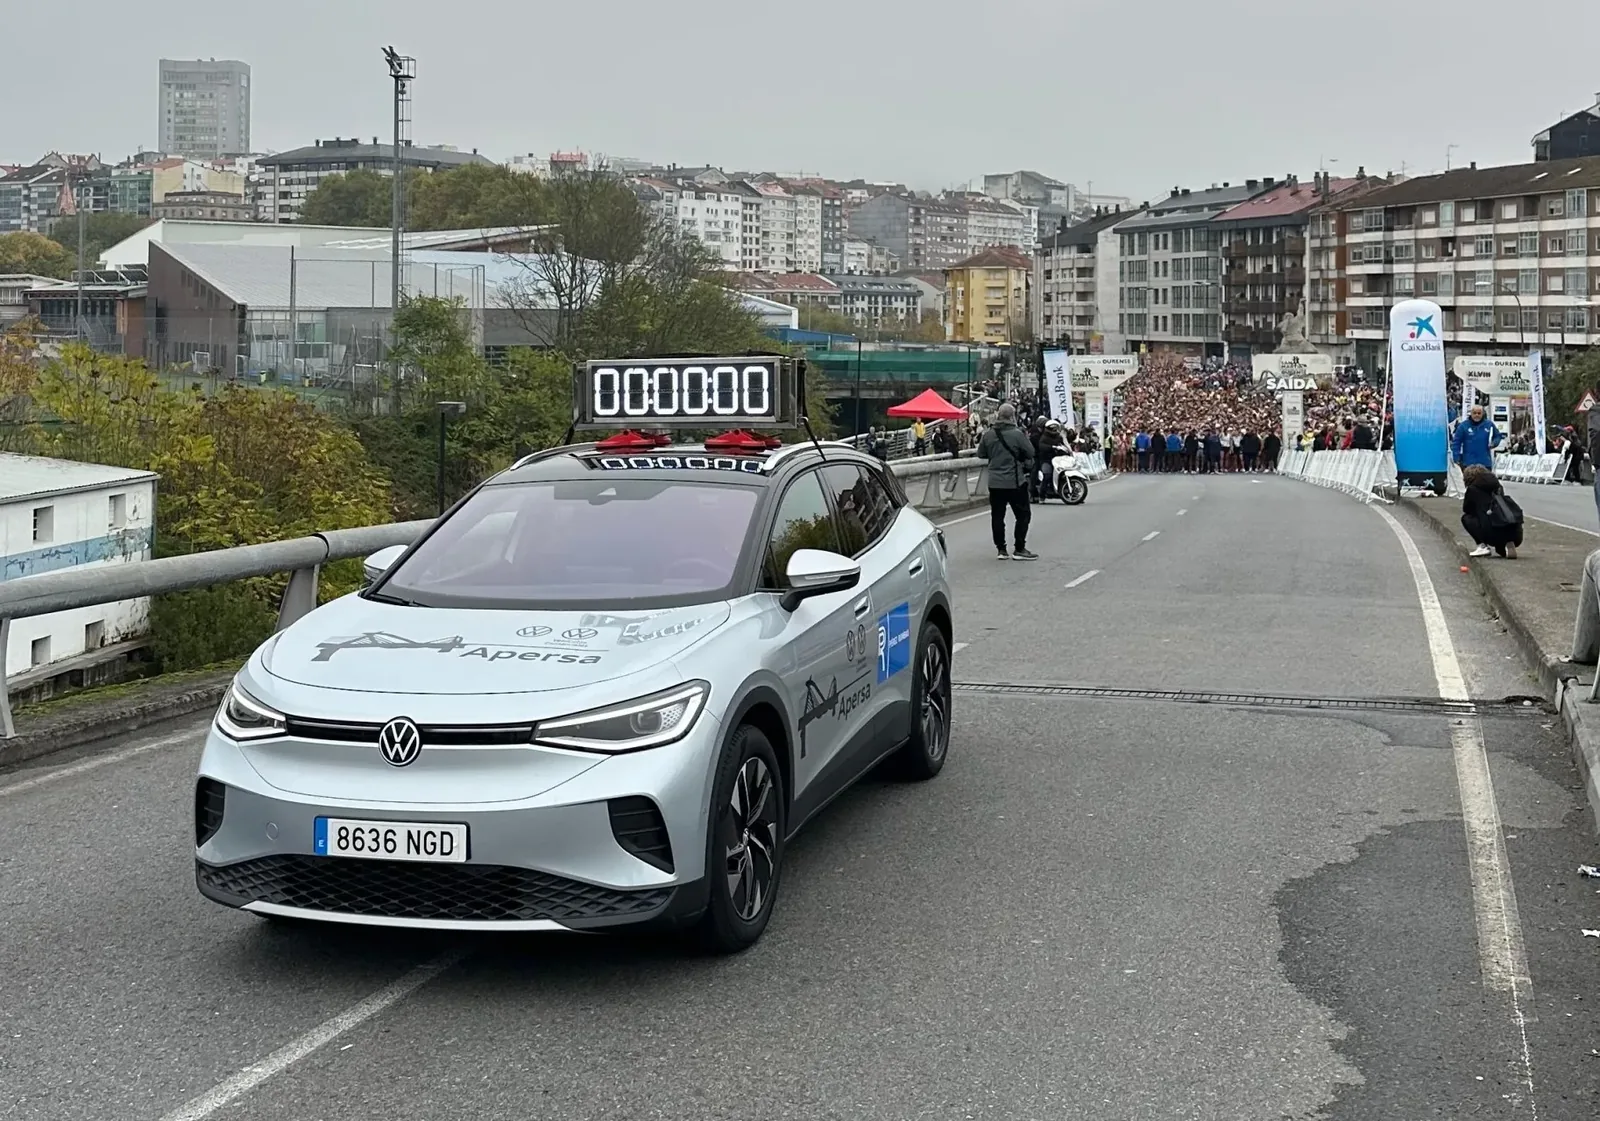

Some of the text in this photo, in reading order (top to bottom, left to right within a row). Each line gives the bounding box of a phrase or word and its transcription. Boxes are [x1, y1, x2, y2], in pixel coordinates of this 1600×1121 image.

[1401, 342, 1441, 352] CaixaBank
[1266, 375, 1318, 390] SAÍDA
[1052, 365, 1069, 425] CaixaBank
[460, 646, 602, 665] Apersa
[837, 683, 871, 721] Apersa
[318, 826, 454, 856] E 8636 NGD
